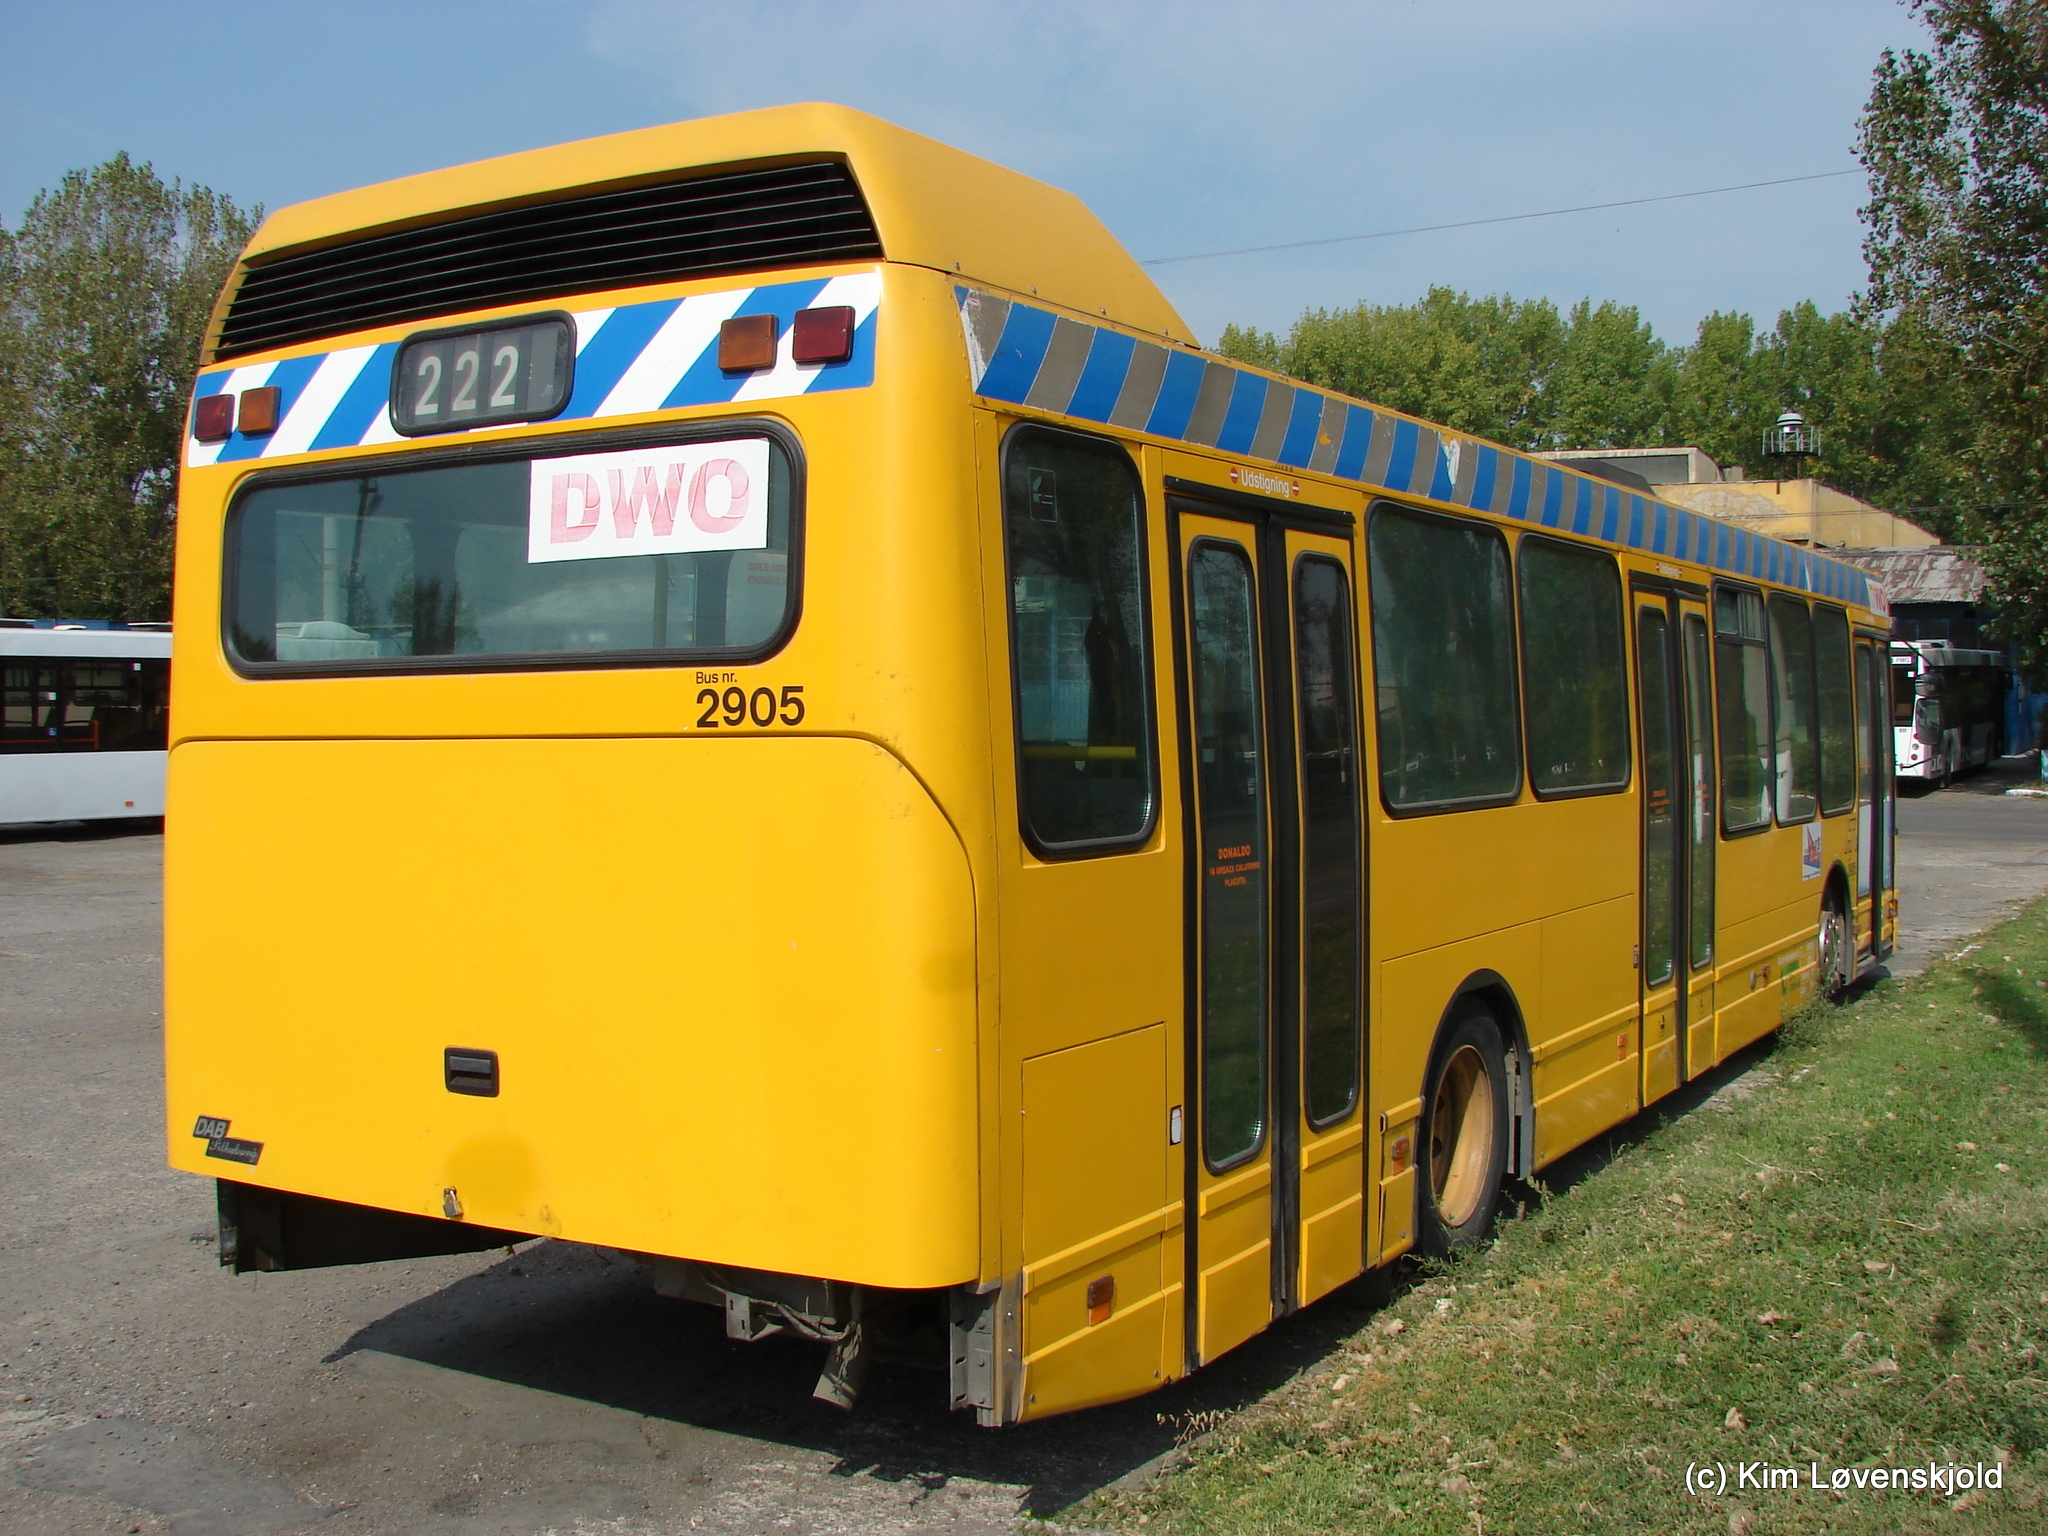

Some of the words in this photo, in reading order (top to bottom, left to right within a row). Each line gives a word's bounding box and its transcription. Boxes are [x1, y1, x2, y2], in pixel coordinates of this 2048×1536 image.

[415, 345, 520, 416] 222
[1240, 469, 1290, 498] Udstigning
[550, 457, 750, 544] DWO
[695, 671, 719, 684] Bus
[722, 671, 738, 683] nr.
[696, 686, 805, 729] 2905
[1218, 845, 1251, 859] DONALDO
[195, 1117, 228, 1138] DAB
